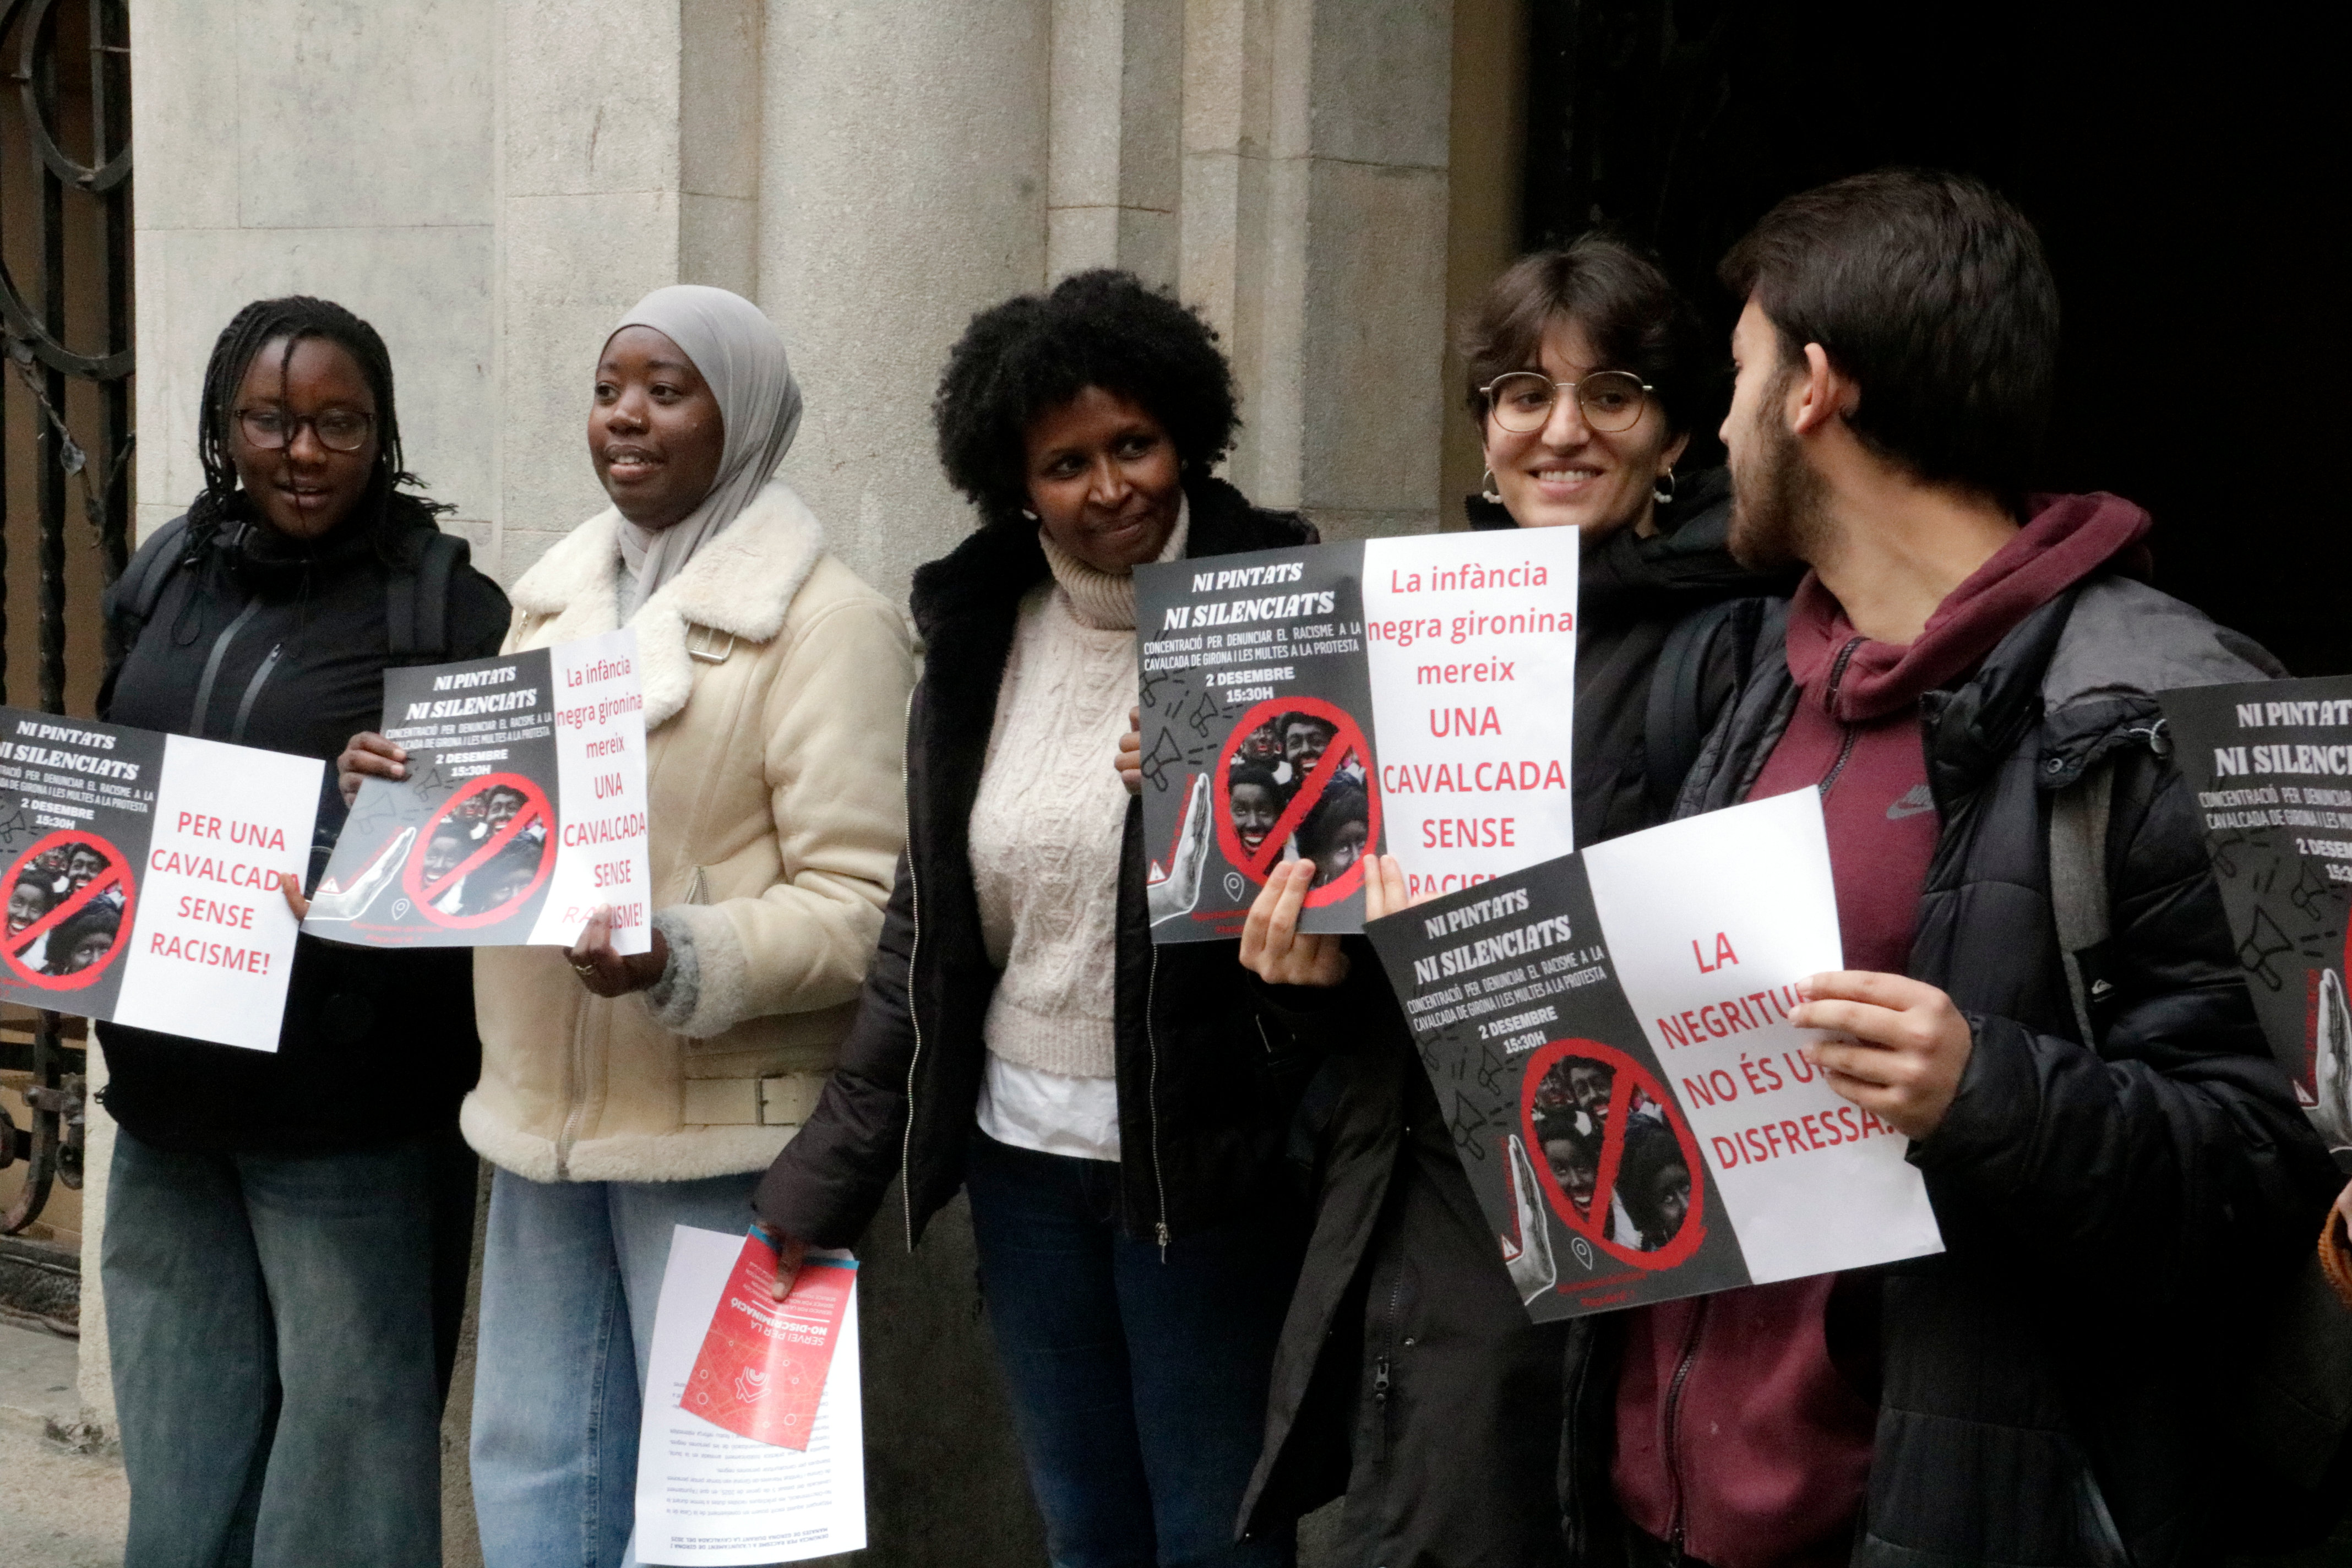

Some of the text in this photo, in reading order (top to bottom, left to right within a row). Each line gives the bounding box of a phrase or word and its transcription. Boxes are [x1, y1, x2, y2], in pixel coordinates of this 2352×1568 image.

[1192, 562, 1304, 593] NI PINTATS
[1391, 560, 1548, 594] La infància
[1163, 591, 1335, 630] NI SILENCIATS
[1368, 607, 1573, 646] negra gironina
[1144, 622, 1362, 655] CONCENTRACIÓ PER DENUNCIAR EL RACISME A LA
[567, 655, 631, 687] La infància
[1144, 639, 1359, 671] CAVALCADA DE GIRONA I LES MULTES A LA PROTESTA
[1418, 656, 1515, 684] mereix
[433, 666, 516, 691] NI PINTATS
[1206, 666, 1295, 687] 2 DESEMBRE
[405, 688, 537, 720] NI SILENCIATS
[557, 692, 643, 729] negra gironina
[1227, 686, 1274, 703] 15:30H
[1430, 706, 1502, 737] UNA
[2236, 703, 2264, 727] NI
[17, 721, 117, 749] NI PINTATS
[586, 732, 624, 759] mereix
[13, 744, 140, 780] SILENCIATS
[435, 749, 509, 764] 2 DESEMBRE
[451, 764, 491, 777] 15:30H
[2214, 747, 2250, 777] NI
[595, 772, 623, 799] UNA
[1384, 760, 1566, 793] CAVALCADA
[20, 798, 95, 820] 2 DESEMBRE
[35, 815, 75, 830] 15:30H
[177, 812, 285, 852] PER UNA
[564, 812, 647, 847] CAVALCADA
[1422, 818, 1515, 848] SENSE
[2296, 838, 2309, 854] 2
[594, 859, 631, 888] SENSE
[177, 896, 254, 929] SENSE
[562, 902, 643, 929] RAISME!
[1424, 888, 1529, 940] NI PINTATS
[150, 932, 270, 975] RACISME!
[1413, 914, 1571, 985] NI SILENCIATS
[1692, 932, 1739, 974] LA
[1407, 945, 1605, 1015] CONCENTRACIÓ PER DENUNCIAR EL RACISME A LA
[1413, 1009, 1458, 1032] CAVALCADA
[1456, 1004, 1469, 1020] DE
[1467, 997, 1497, 1016] GIRONA
[1499, 992, 1515, 1008] LES
[1513, 983, 1546, 1004] MULTES
[1545, 981, 1554, 995] A
[1551, 977, 1566, 993] LA
[1562, 966, 1607, 989] PROTESTA
[1478, 1005, 1558, 1039] 2 DESEMBRE
[1657, 983, 1805, 1049] NEGRITU
[1504, 1030, 1547, 1054] 15:30H
[1683, 1069, 1738, 1109] NO
[1740, 1053, 1783, 1095] ÉS
[731, 1298, 827, 1336] NO-DISCRIMINACIÓ
[750, 1320, 824, 1346] SERVEI PER LA
